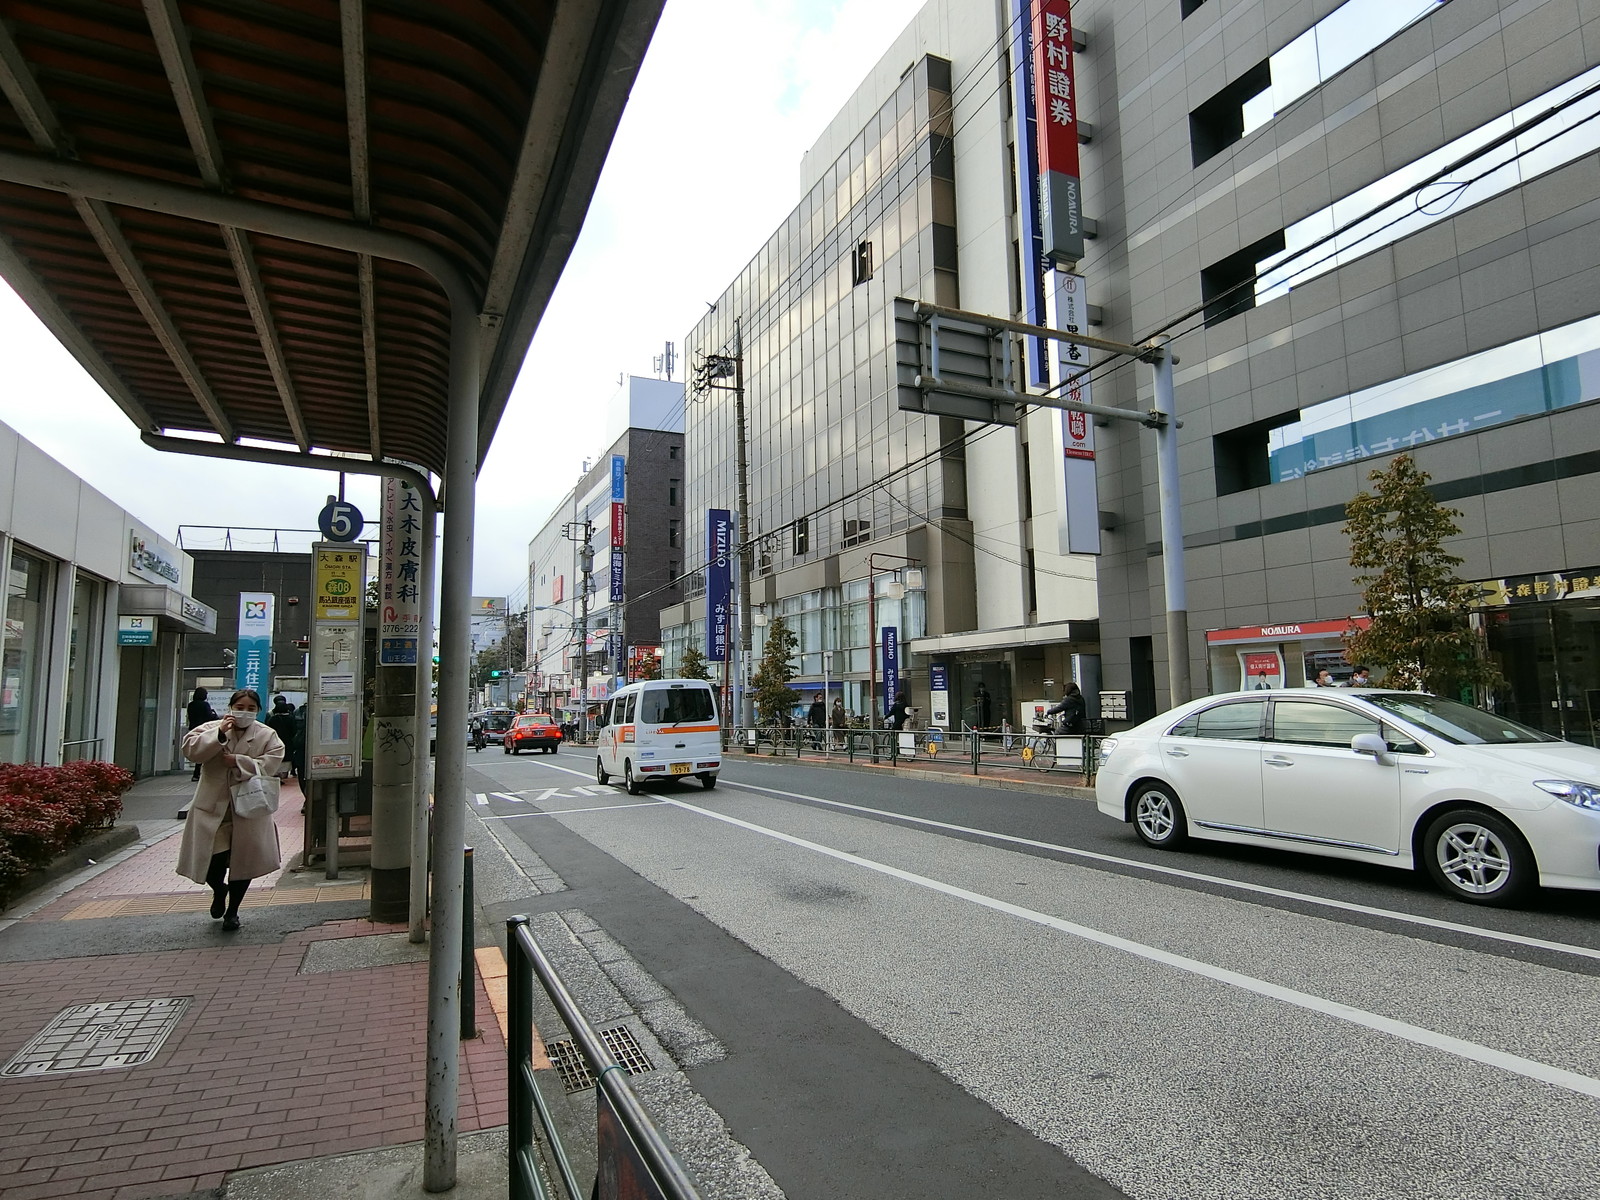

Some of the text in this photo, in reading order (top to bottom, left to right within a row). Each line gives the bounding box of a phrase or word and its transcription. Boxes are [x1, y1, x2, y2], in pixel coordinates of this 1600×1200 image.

[1045, 12, 1073, 127] 野村證券
[1066, 180, 1078, 236] NOMURA
[1067, 296, 1075, 323] 株式会社
[330, 507, 352, 537] 5
[320, 553, 358, 563] 大森駅
[397, 492, 422, 604] 大木皮膚科
[716, 520, 727, 568] MIZUHO
[328, 581, 350, 593] 森08
[613, 553, 622, 595] 臨海セミナー
[715, 604, 726, 656] みずほ銀行
[1261, 625, 1301, 636] NOMURA
